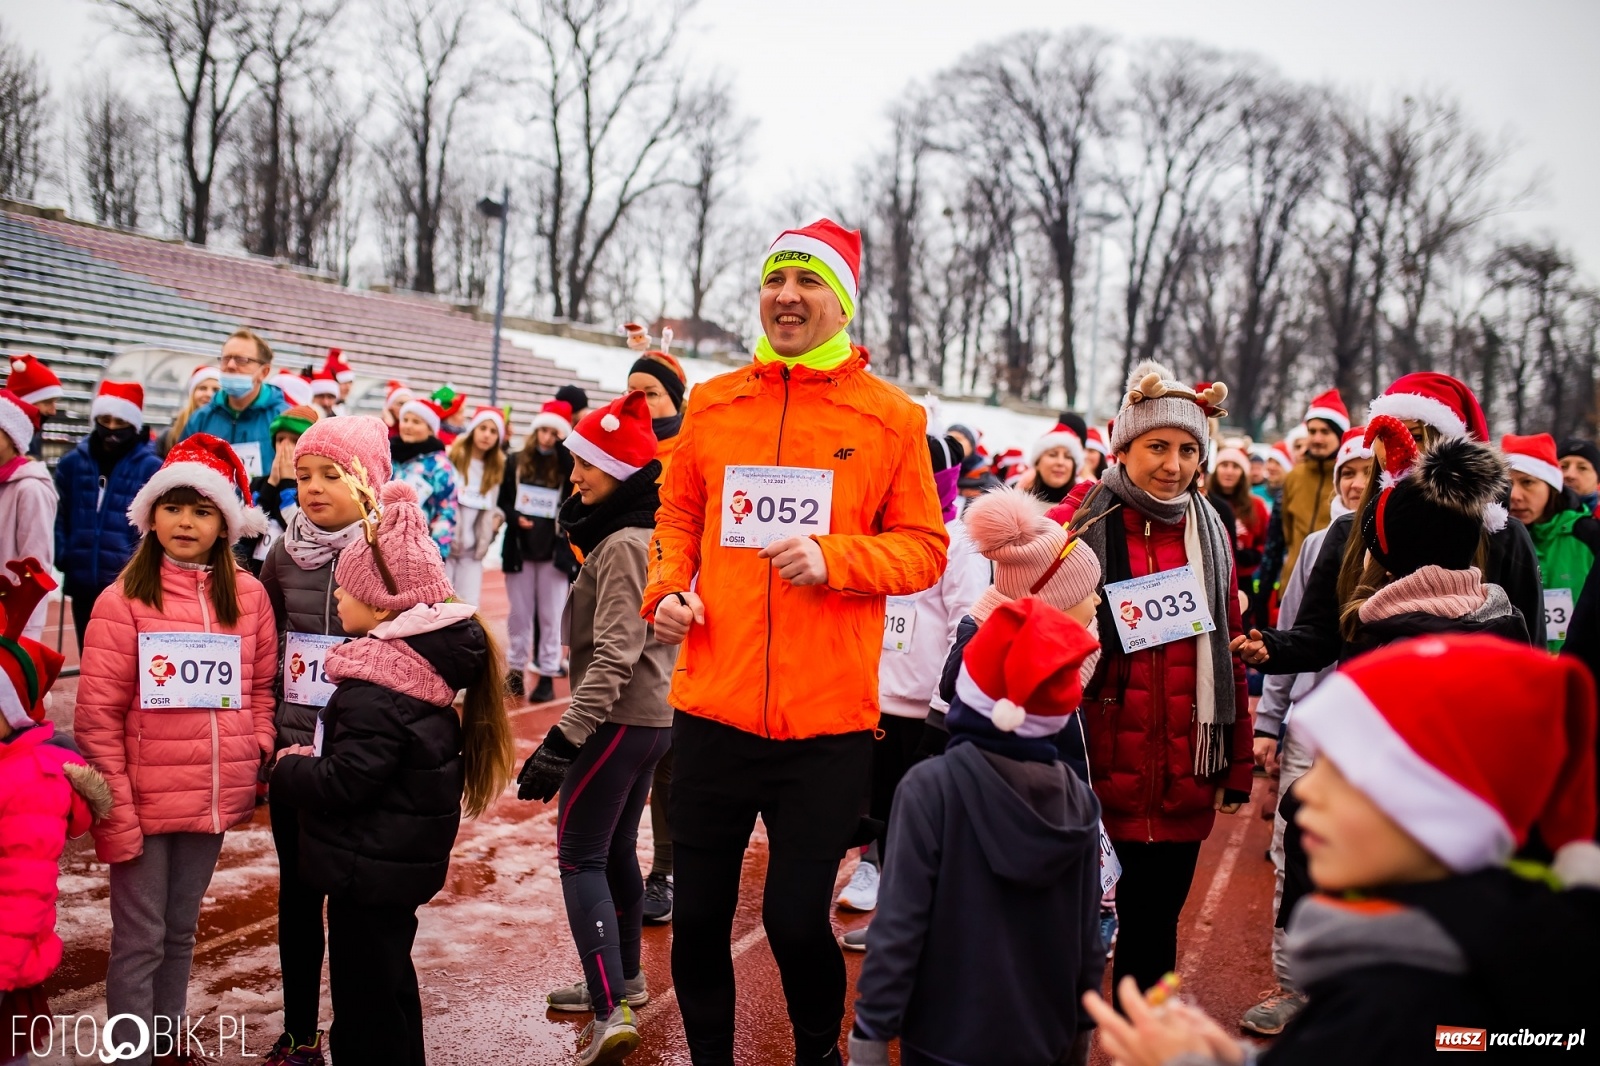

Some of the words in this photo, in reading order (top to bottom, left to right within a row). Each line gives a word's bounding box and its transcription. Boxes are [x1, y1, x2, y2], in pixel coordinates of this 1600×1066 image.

[777, 252, 809, 261] HERO
[833, 448, 855, 460] 4F
[756, 496, 819, 525] 052
[1145, 590, 1197, 621] 033
[180, 659, 233, 685] 079
